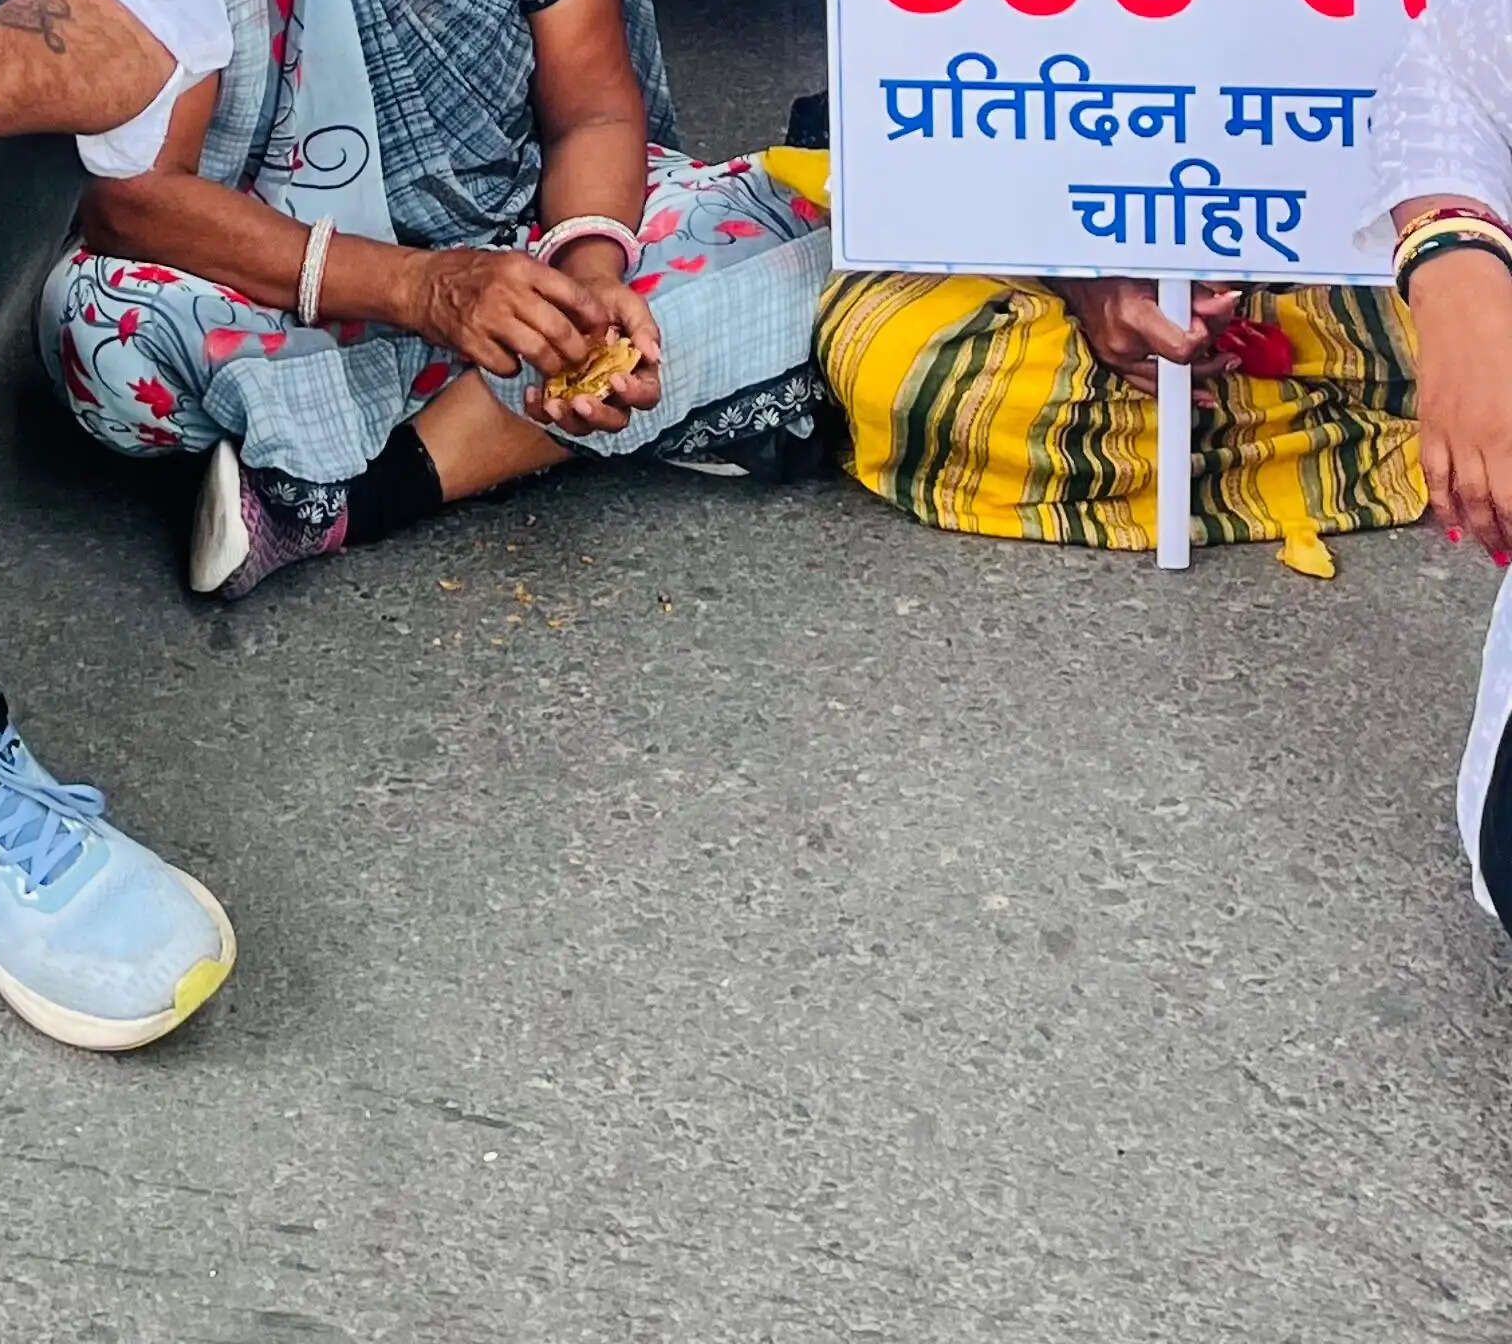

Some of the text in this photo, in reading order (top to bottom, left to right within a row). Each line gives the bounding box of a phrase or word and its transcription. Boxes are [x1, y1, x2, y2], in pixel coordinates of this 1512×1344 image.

[879, 51, 1378, 148] प्रतिदिन मज
[1067, 157, 1308, 263] चाहिए
